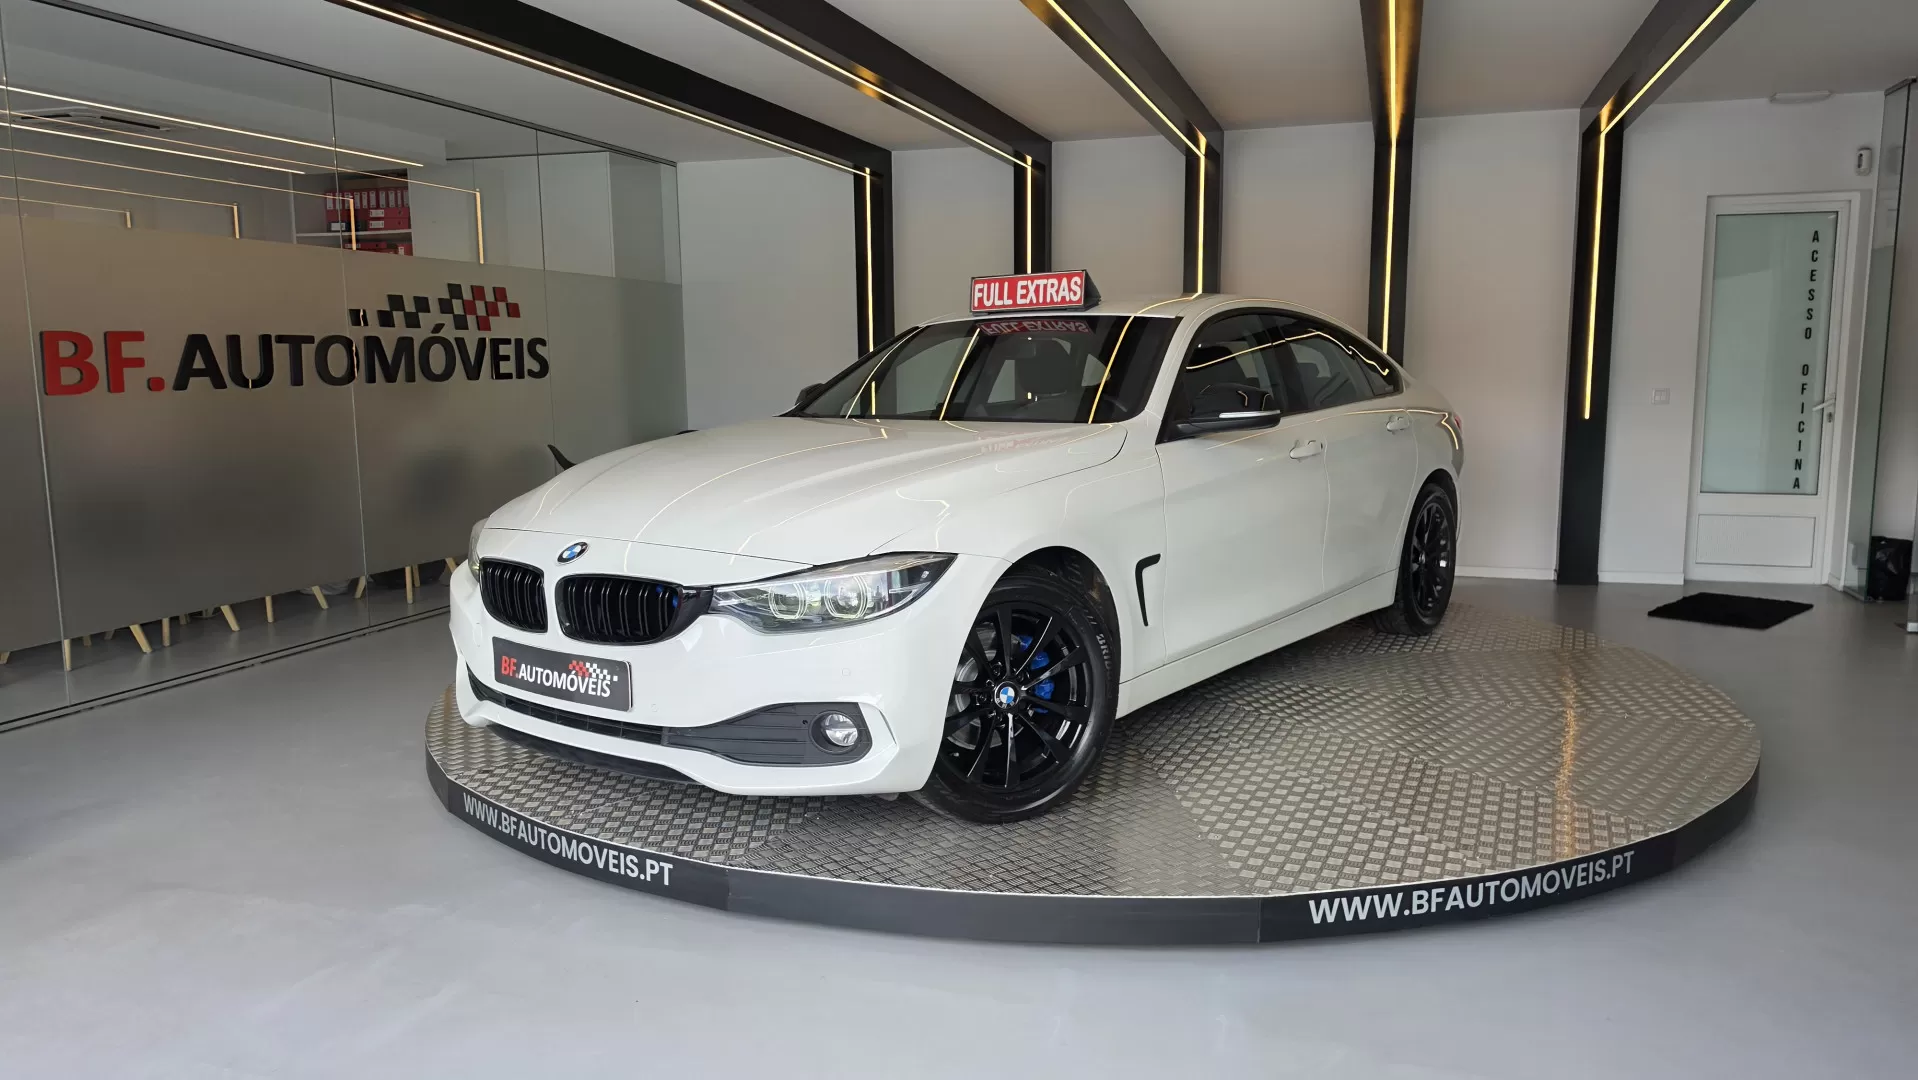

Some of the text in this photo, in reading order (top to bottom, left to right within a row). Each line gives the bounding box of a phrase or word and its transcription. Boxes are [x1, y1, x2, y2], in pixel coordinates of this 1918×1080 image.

[974, 276, 1081, 307] FULL EXTRAS
[1792, 229, 1820, 489] ACESSO OFICINA
[463, 792, 674, 886] WWW.BFAUTOMOVEIS.PT
[1308, 850, 1635, 924] WWW.BFAUTOMOVEIS.PT
